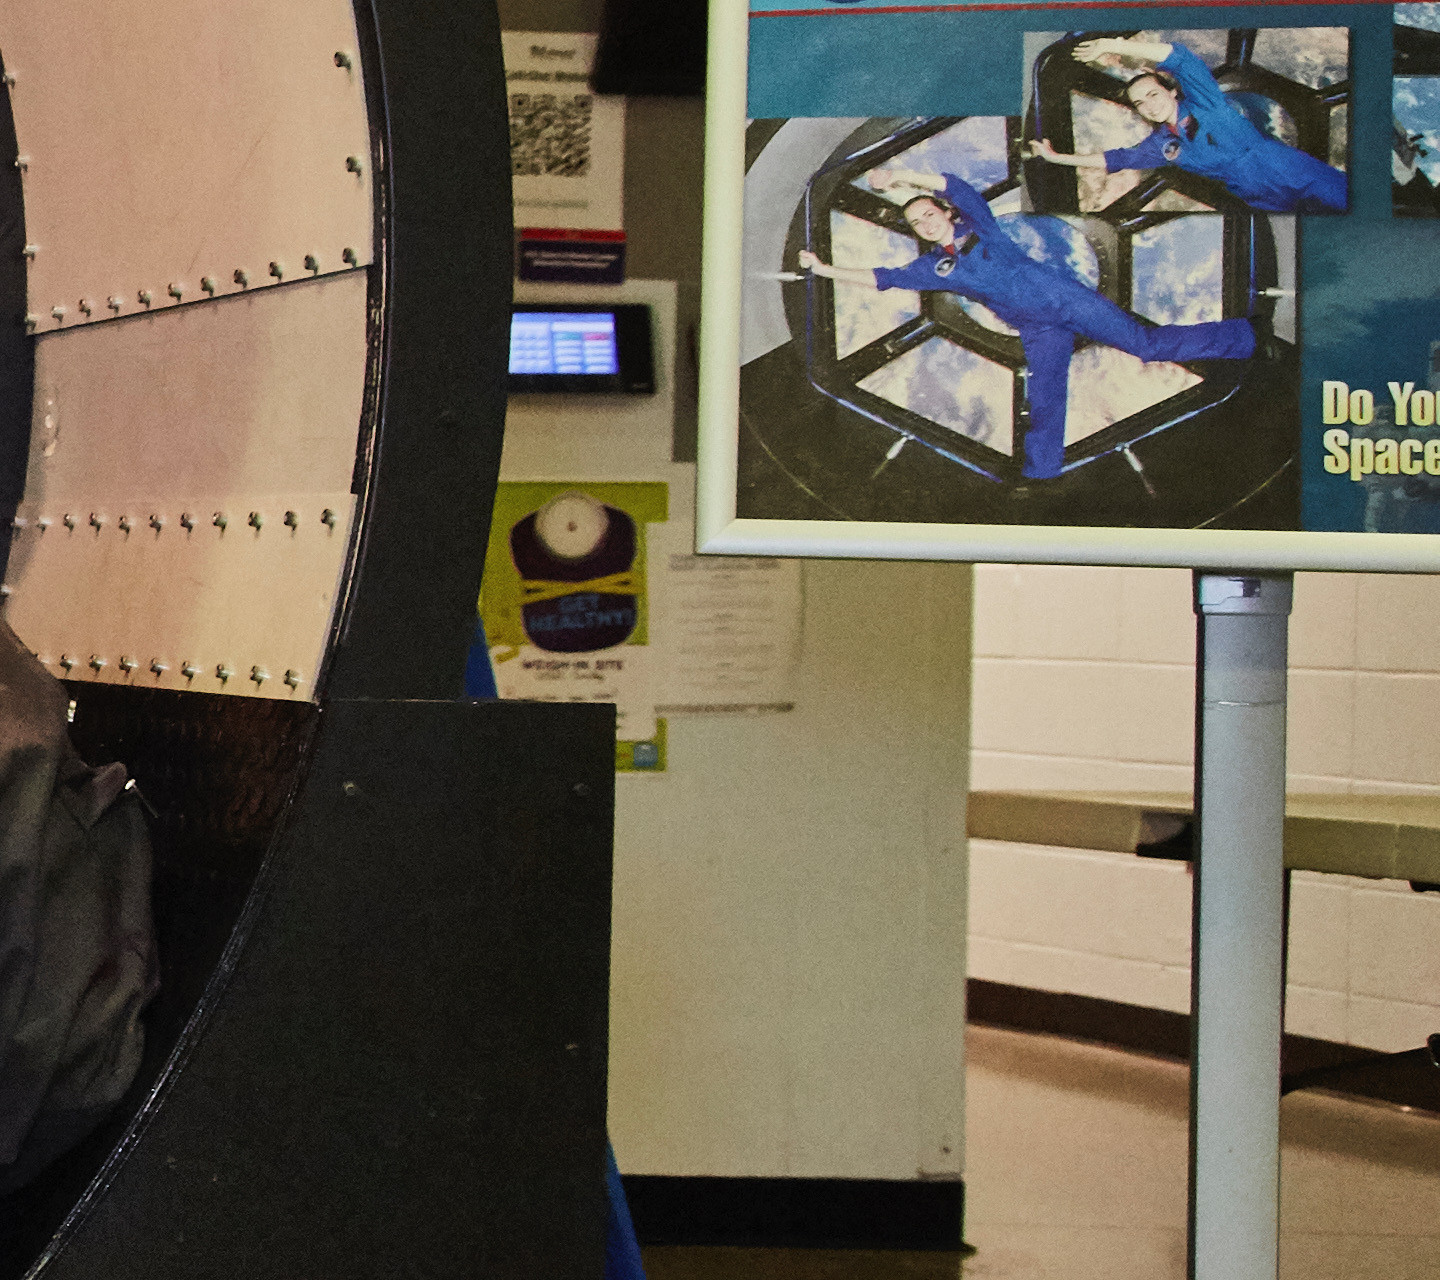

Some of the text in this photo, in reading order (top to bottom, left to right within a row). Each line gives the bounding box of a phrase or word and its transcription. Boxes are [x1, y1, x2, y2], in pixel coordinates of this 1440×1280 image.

[1322, 380, 1440, 427] Do Yo
[1323, 428, 1440, 481] Space
